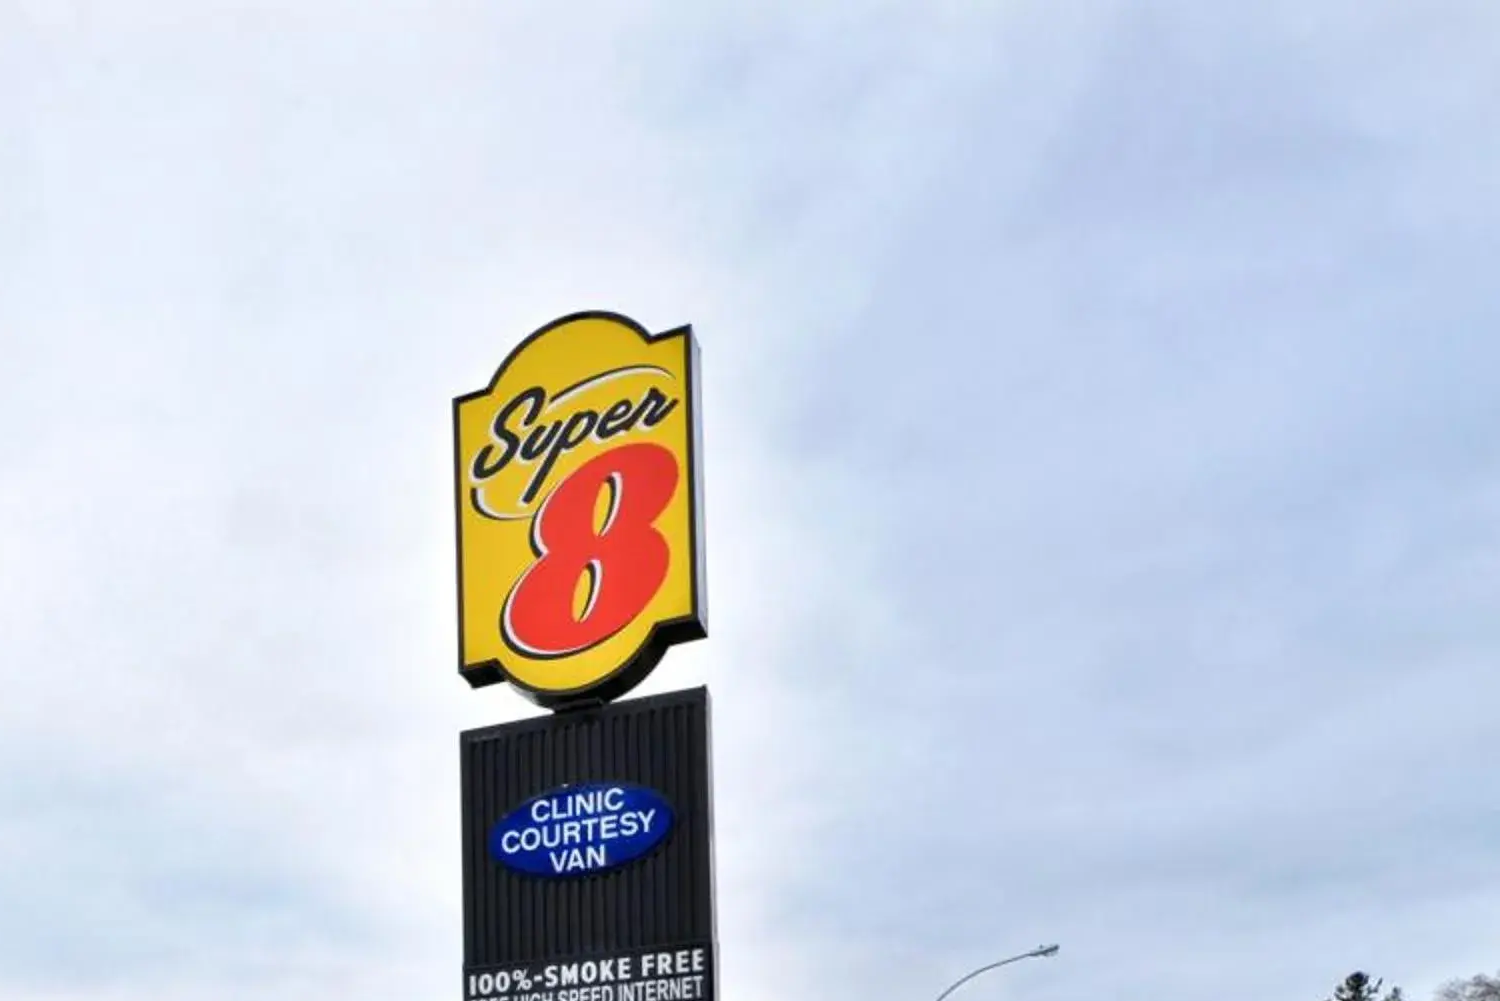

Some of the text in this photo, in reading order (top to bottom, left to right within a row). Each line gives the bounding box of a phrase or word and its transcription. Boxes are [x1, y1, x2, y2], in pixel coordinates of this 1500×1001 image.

[472, 385, 680, 505] Super
[500, 441, 679, 660] 8
[531, 787, 625, 823] CLINIC
[501, 808, 656, 854] COURTESY
[549, 844, 606, 873] VAN
[641, 948, 705, 978] FREE
